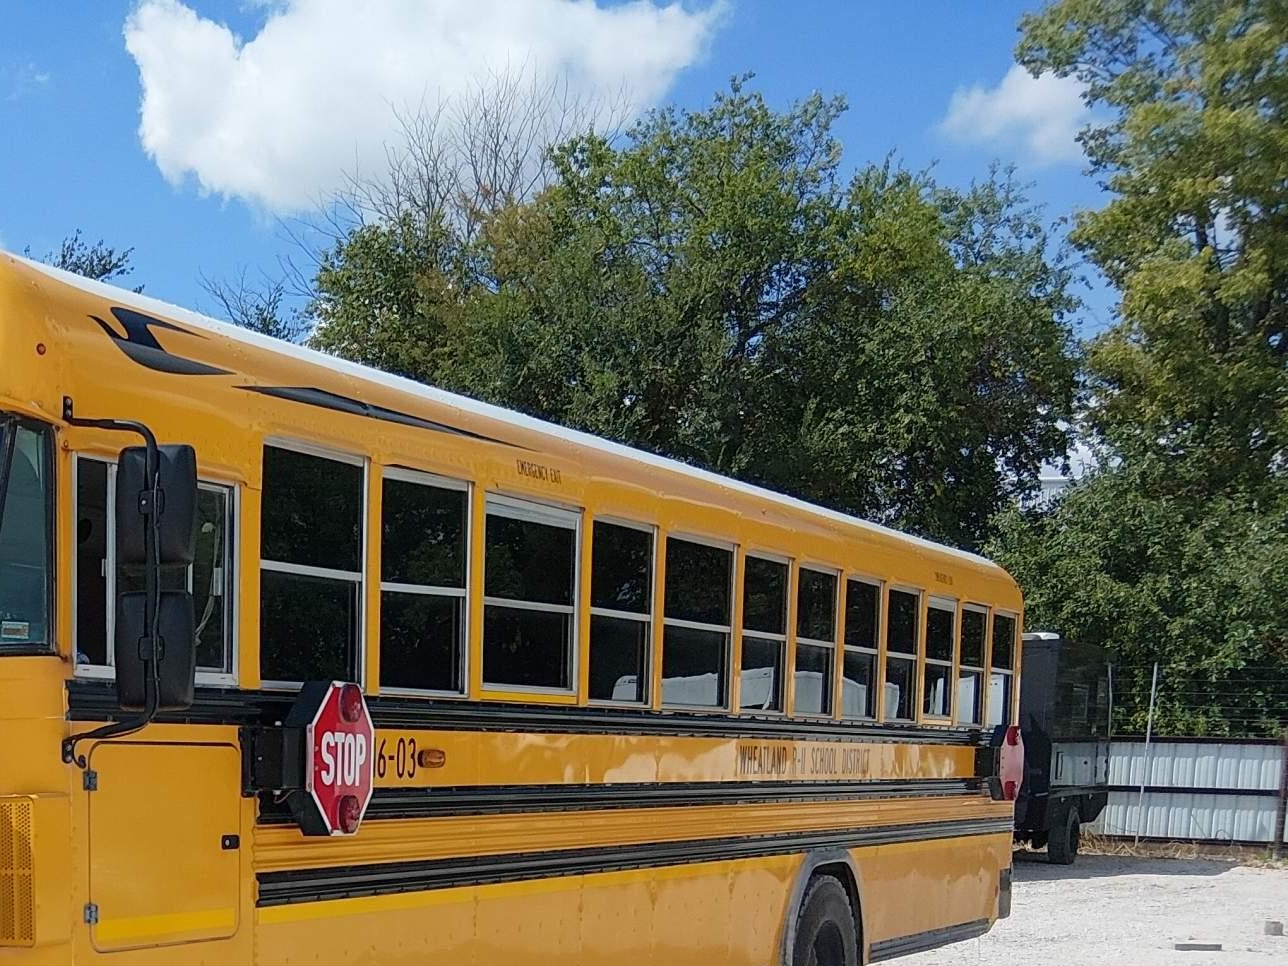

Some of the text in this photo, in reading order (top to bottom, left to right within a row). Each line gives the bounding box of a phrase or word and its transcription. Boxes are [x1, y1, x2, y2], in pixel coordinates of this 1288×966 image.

[321, 731, 367, 787] STOP
[739, 745, 787, 775] WHEATLAND
[811, 746, 837, 775] SCHOOL
[842, 748, 871, 774] DISTRICT
